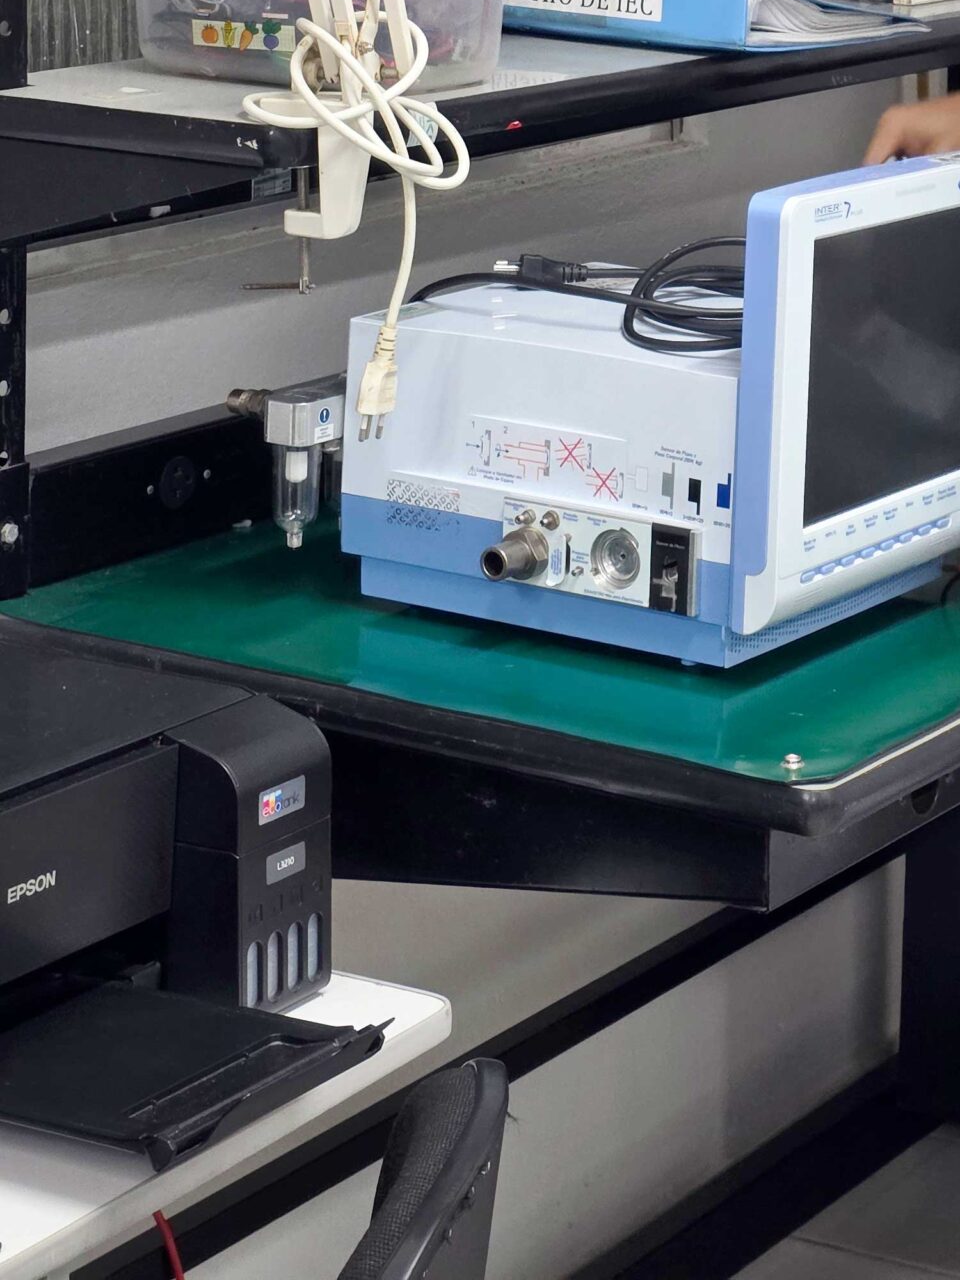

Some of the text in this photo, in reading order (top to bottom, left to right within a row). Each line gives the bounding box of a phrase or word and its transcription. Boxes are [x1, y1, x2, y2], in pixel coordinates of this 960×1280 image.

[472, 421, 476, 429] 1
[503, 426, 508, 434] 2
[8, 870, 56, 904] EPSON
